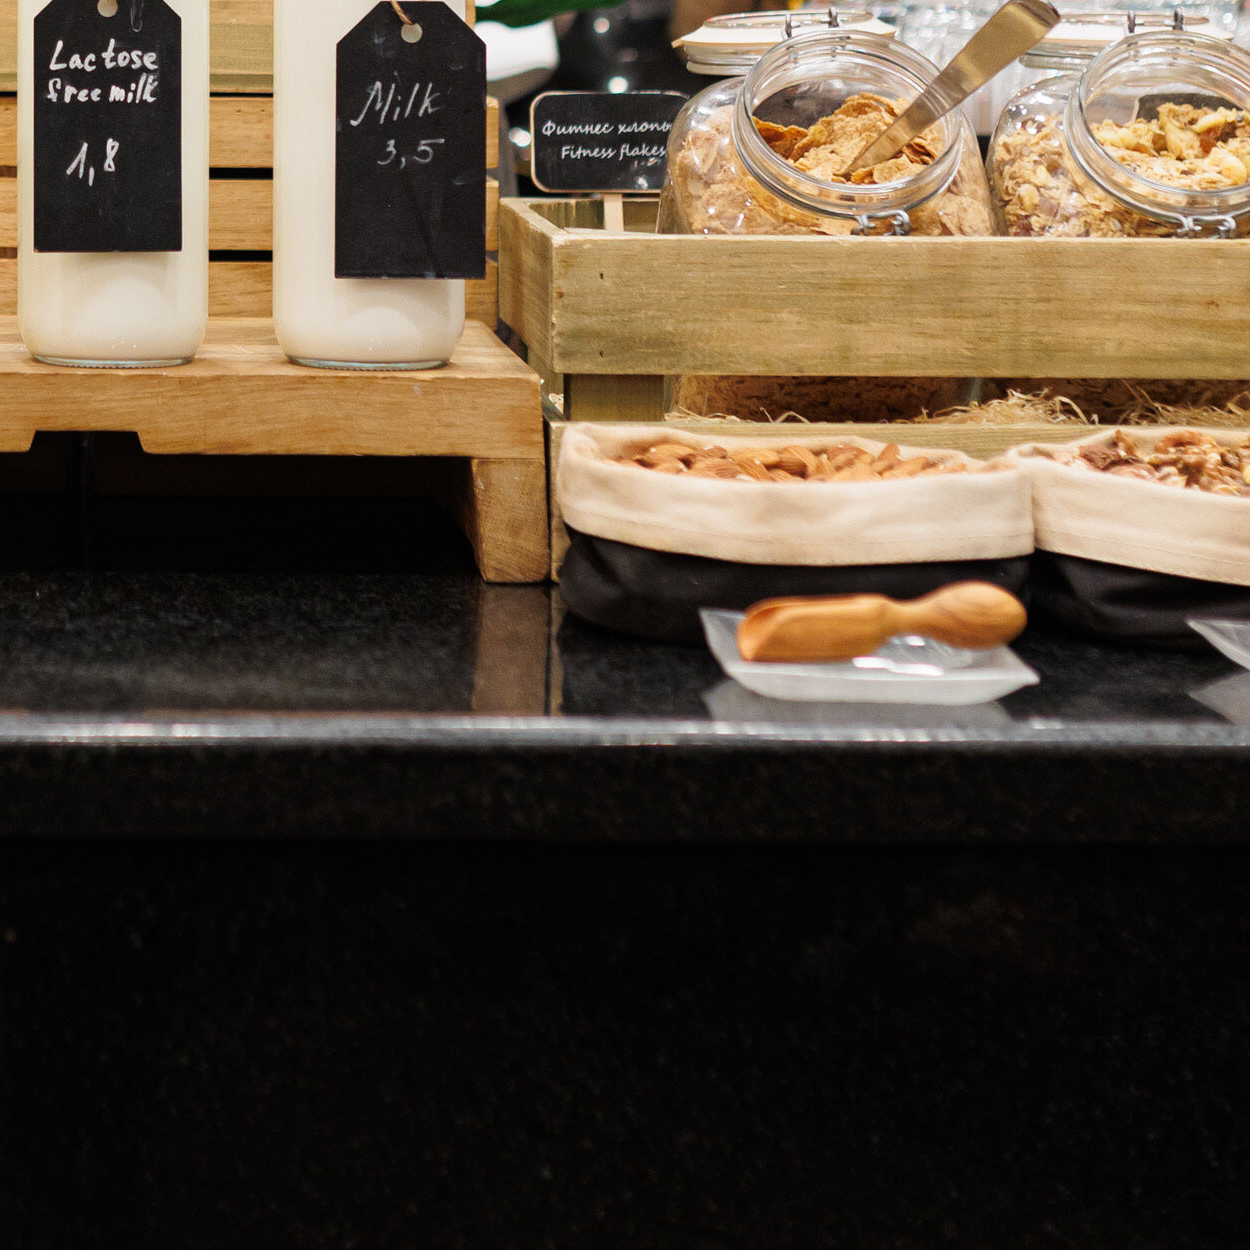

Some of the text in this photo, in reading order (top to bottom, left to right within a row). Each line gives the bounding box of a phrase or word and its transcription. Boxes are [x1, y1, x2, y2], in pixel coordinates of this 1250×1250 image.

[49, 38, 158, 72] Lactose
[47, 73, 158, 103] free milk
[349, 80, 442, 126] Milk
[542, 120, 671, 136] Фитнес хлопь
[66, 138, 120, 187] 1,8
[377, 138, 445, 170] 3,5
[561, 143, 668, 161] Fitness flakes
